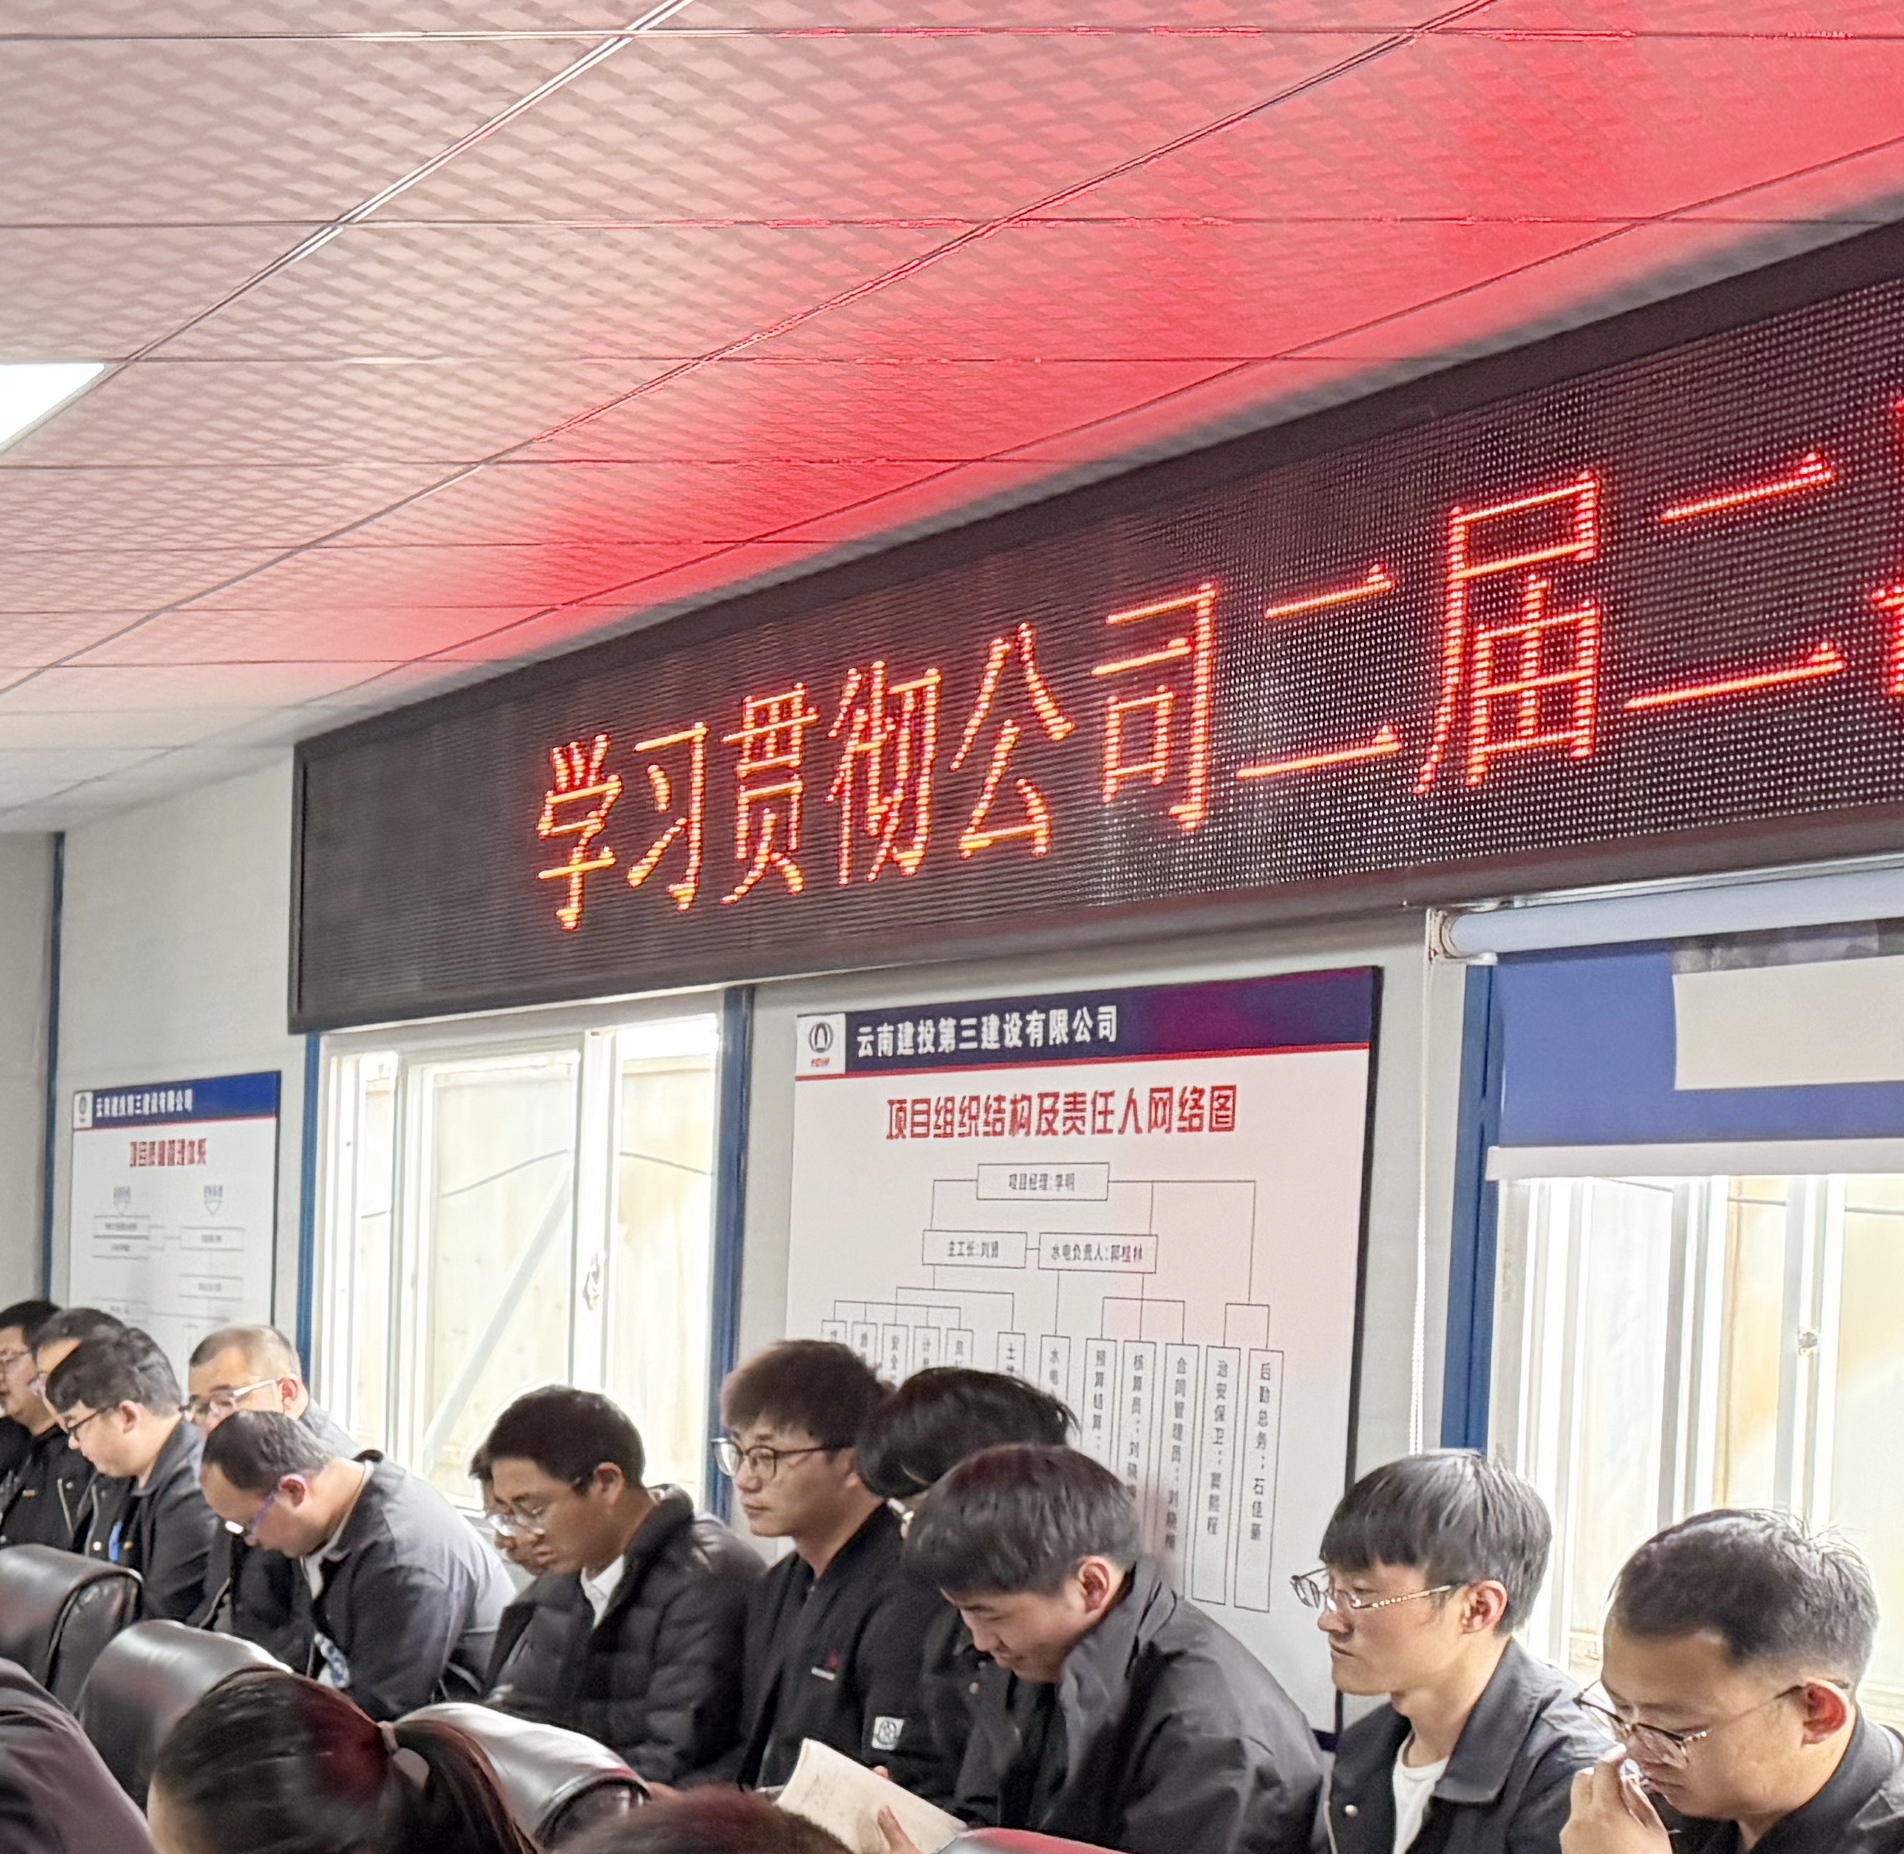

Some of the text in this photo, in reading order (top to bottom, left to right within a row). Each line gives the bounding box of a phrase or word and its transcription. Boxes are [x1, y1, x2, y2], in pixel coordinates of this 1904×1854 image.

[537, 398, 1904, 931] 学习贯彻公司二届二
[857, 1005, 1118, 1058] 云南建投第三建设有限公司
[885, 1084, 1237, 1141] 项目组织结构及责任人网络图
